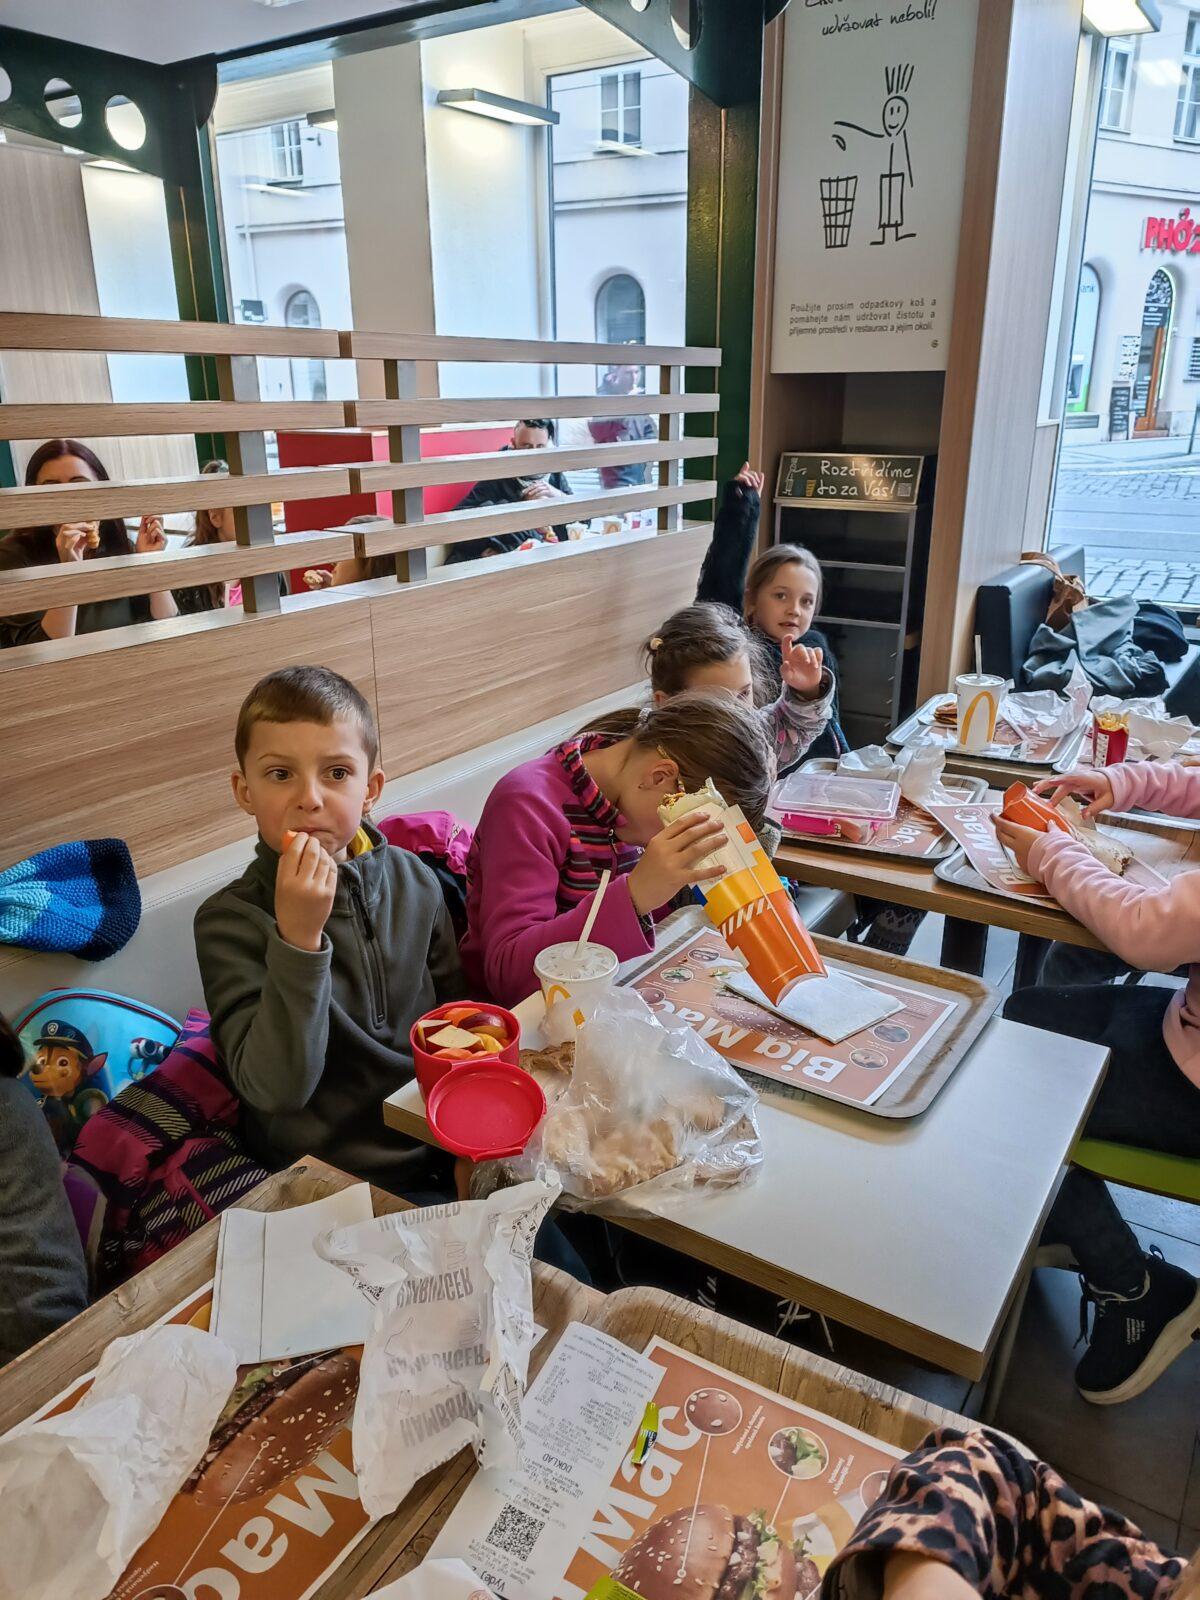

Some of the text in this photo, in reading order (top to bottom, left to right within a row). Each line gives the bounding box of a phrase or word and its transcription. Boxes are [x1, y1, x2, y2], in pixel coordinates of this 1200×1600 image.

[822, 14, 883, 36] udržovat
[910, 298, 925, 307] koš
[856, 311, 891, 321] udržovat
[820, 460, 914, 478] Roztřídíme
[817, 480, 896, 497] to za Vás!
[954, 814, 994, 852] Mac
[753, 1036, 847, 1083] Big
